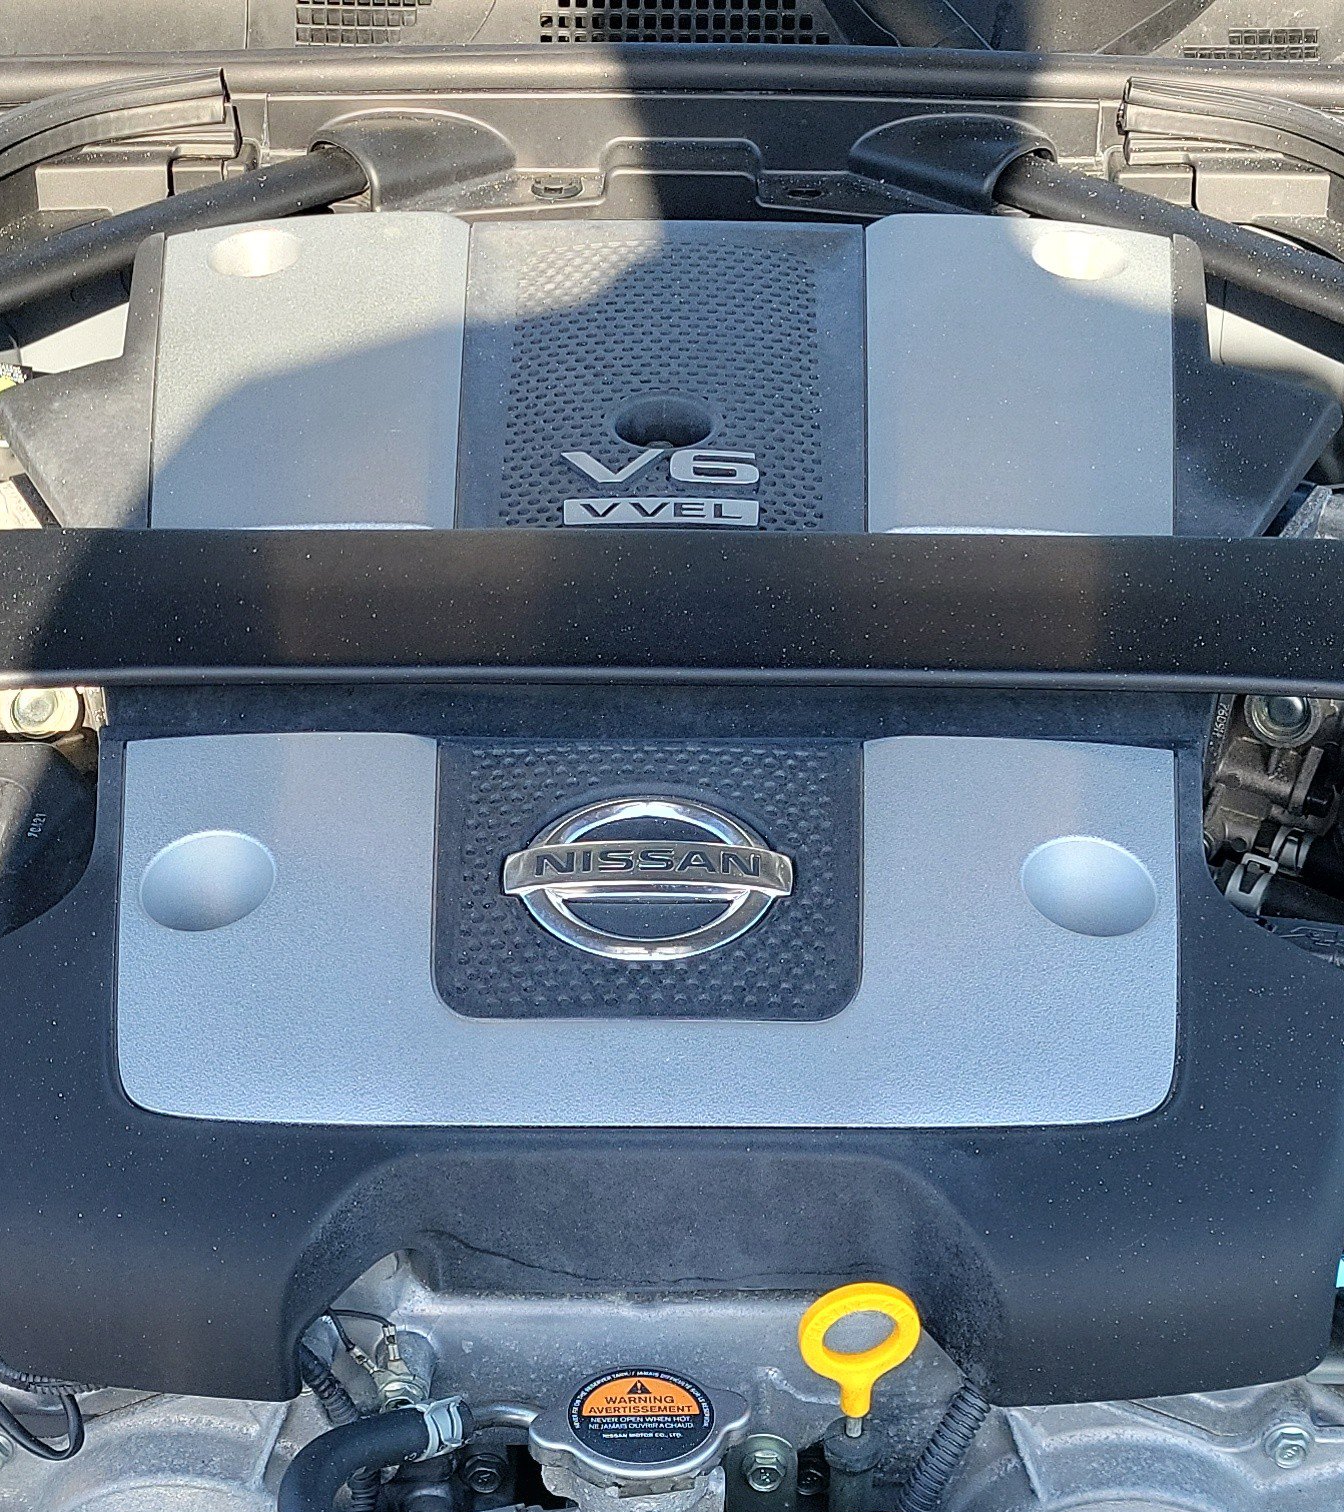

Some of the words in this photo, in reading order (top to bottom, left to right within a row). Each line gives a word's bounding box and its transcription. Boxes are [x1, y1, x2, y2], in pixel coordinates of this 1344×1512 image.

[561, 449, 759, 485] V6
[579, 502, 742, 520] VVEL
[534, 848, 761, 878] NISSAN
[604, 1395, 675, 1405] WARNING
[588, 1405, 693, 1414] AVERTISSEMENT
[588, 1422, 600, 1430] NE
[600, 1422, 628, 1430] JAMAIS
[628, 1422, 659, 1430] OUVRIR
[664, 1422, 694, 1430] CHAUD.
